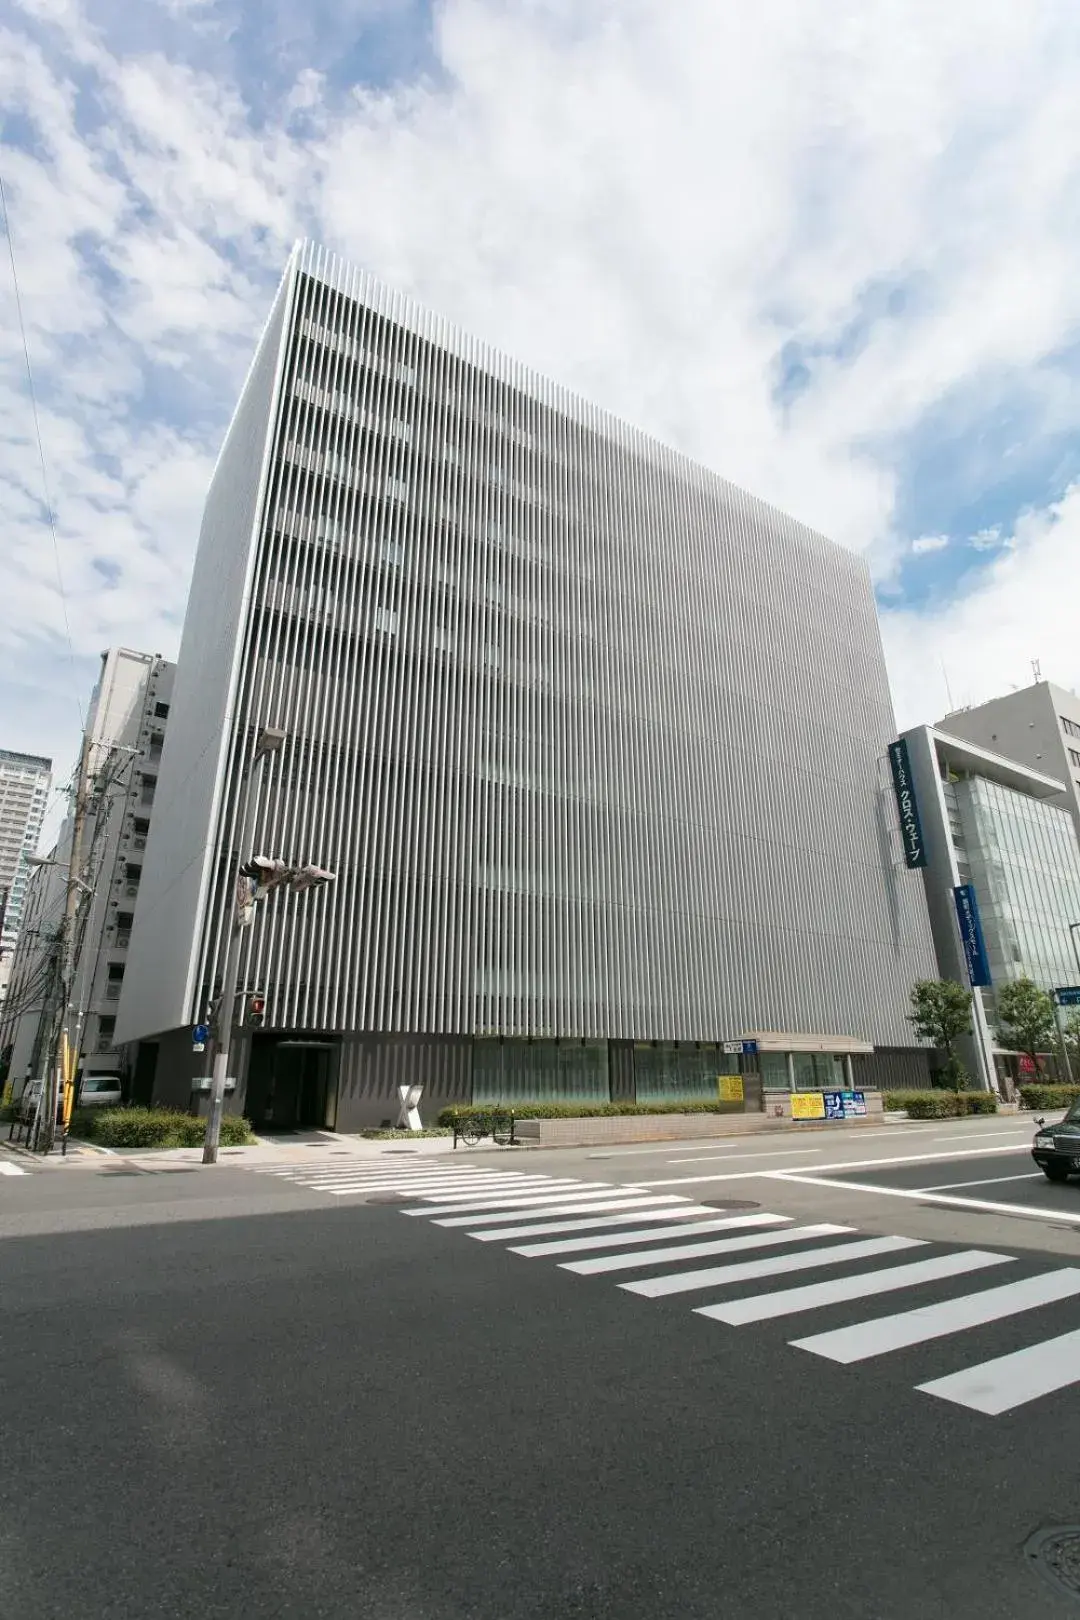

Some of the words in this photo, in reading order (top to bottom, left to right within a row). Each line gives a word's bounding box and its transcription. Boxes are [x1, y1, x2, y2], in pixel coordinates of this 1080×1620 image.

[901, 790, 920, 861] クロス・ウェーブ
